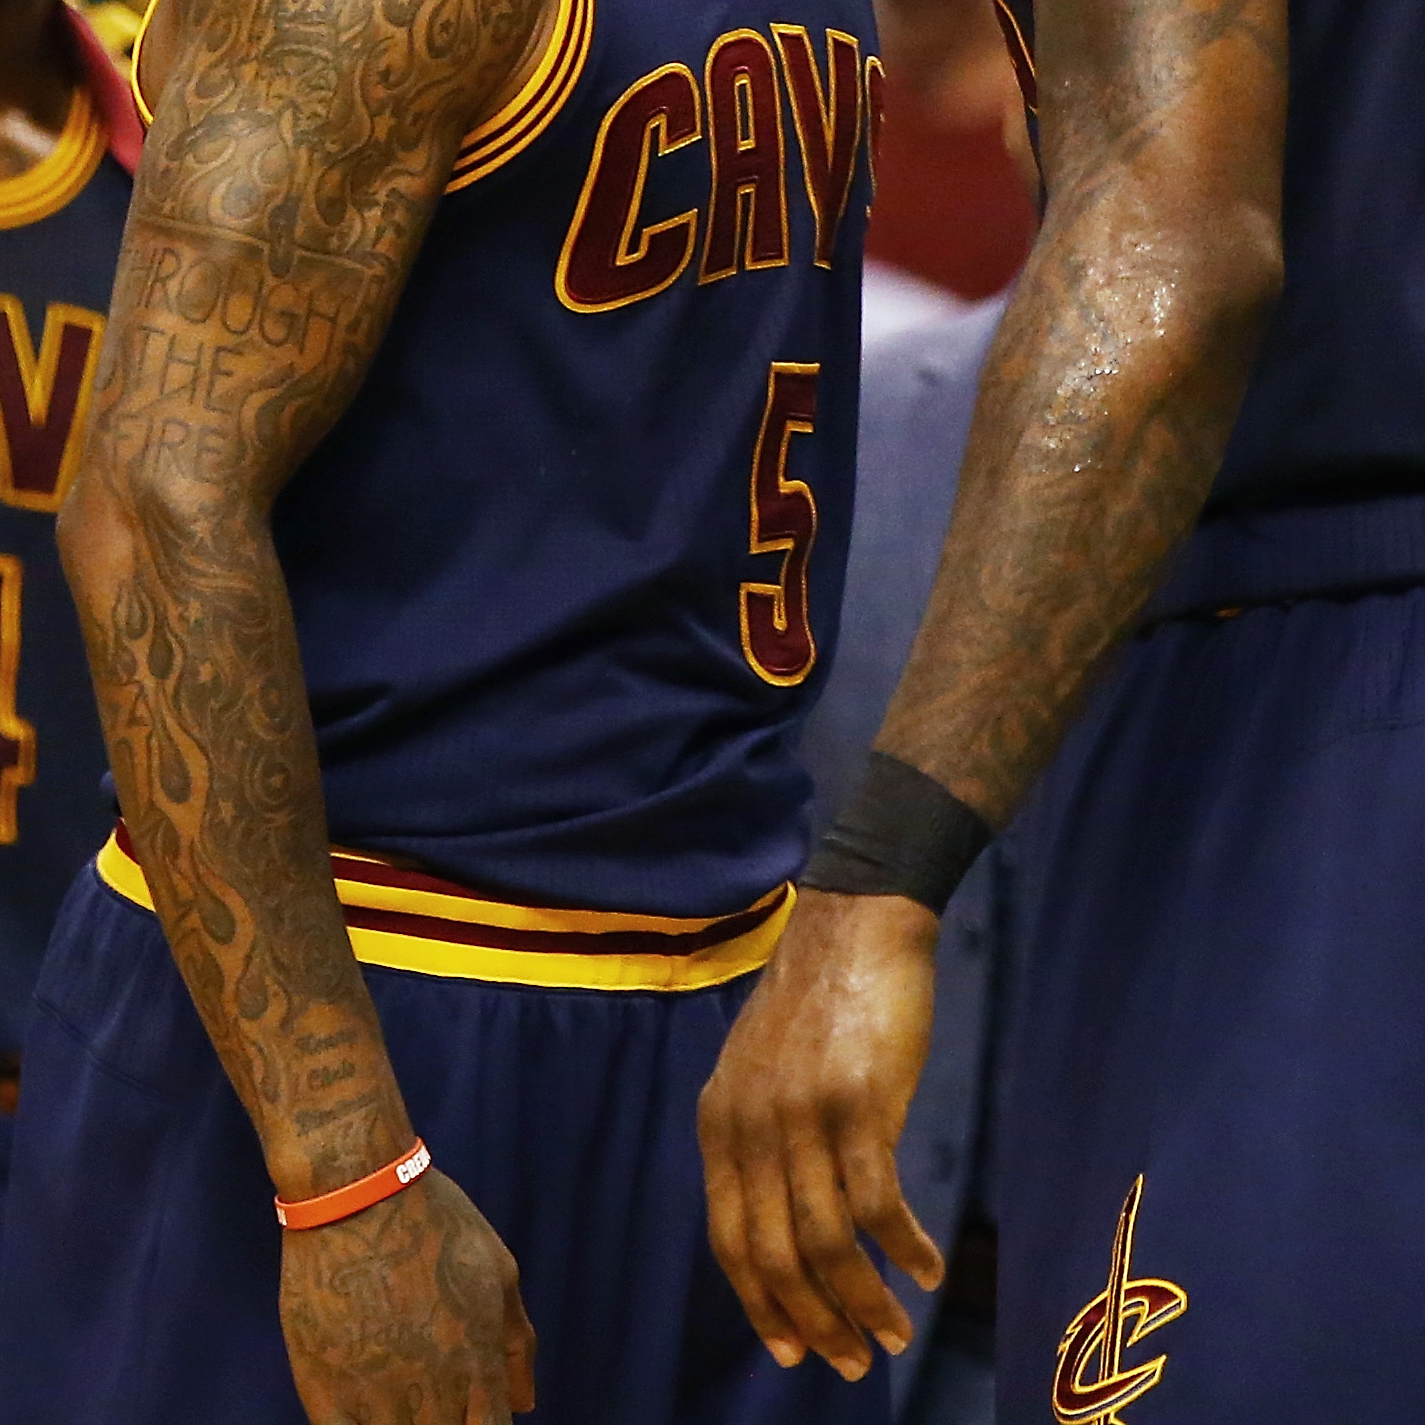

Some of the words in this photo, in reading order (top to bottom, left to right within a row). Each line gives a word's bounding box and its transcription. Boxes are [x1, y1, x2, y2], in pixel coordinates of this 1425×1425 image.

[554, 22, 886, 314] CAV
[135, 324, 245, 414] THE
[738, 361, 821, 687] 5
